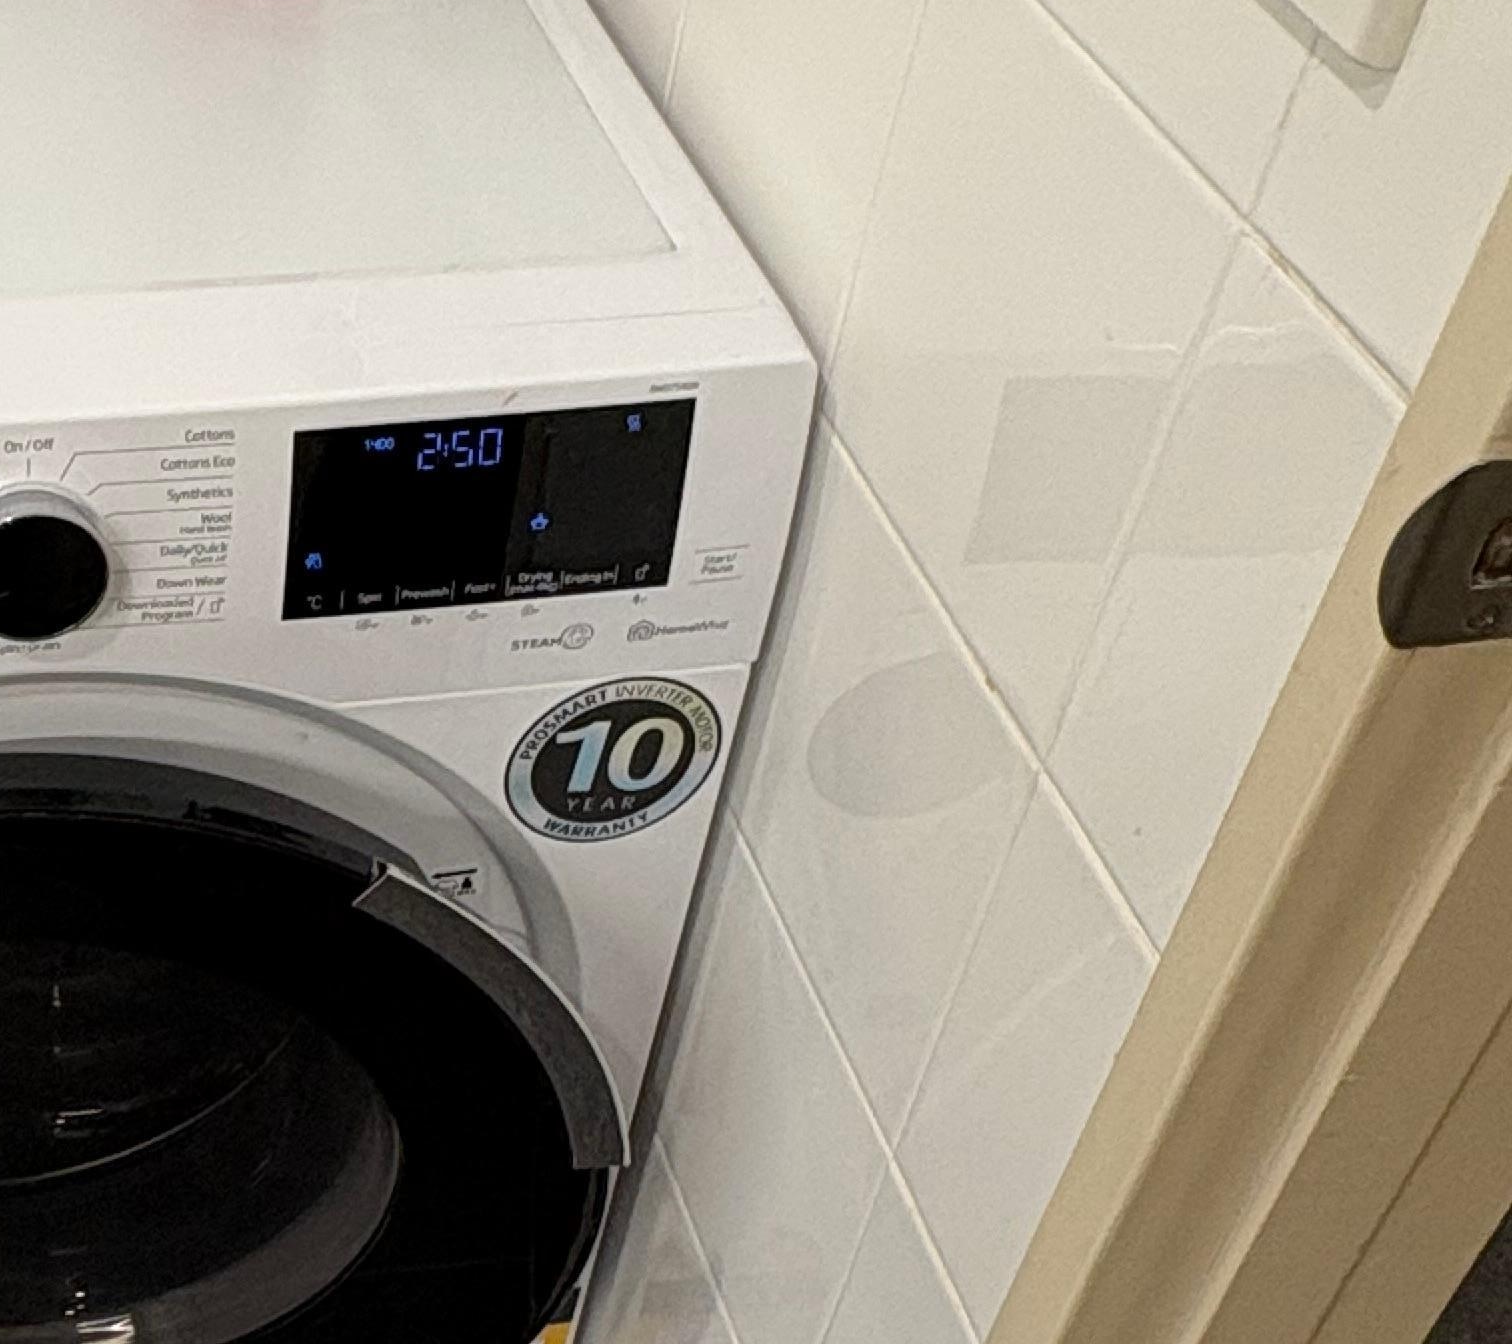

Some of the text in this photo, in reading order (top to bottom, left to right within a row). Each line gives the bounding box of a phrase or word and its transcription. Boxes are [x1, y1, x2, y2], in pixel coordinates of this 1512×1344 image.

[184, 428, 236, 444] Cottons
[4, 440, 24, 454] On
[32, 438, 54, 451] Off
[417, 427, 504, 471] 2:50
[160, 454, 235, 472] Cottons Eco
[167, 487, 234, 504] Synthetics
[200, 512, 232, 525] Wool
[511, 637, 562, 651] STEAM
[520, 689, 608, 761] PROSMART
[614, 683, 693, 709] INVERTER
[555, 717, 685, 793] 10
[566, 795, 637, 813] YEAR
[543, 810, 650, 838] WARRANTY
